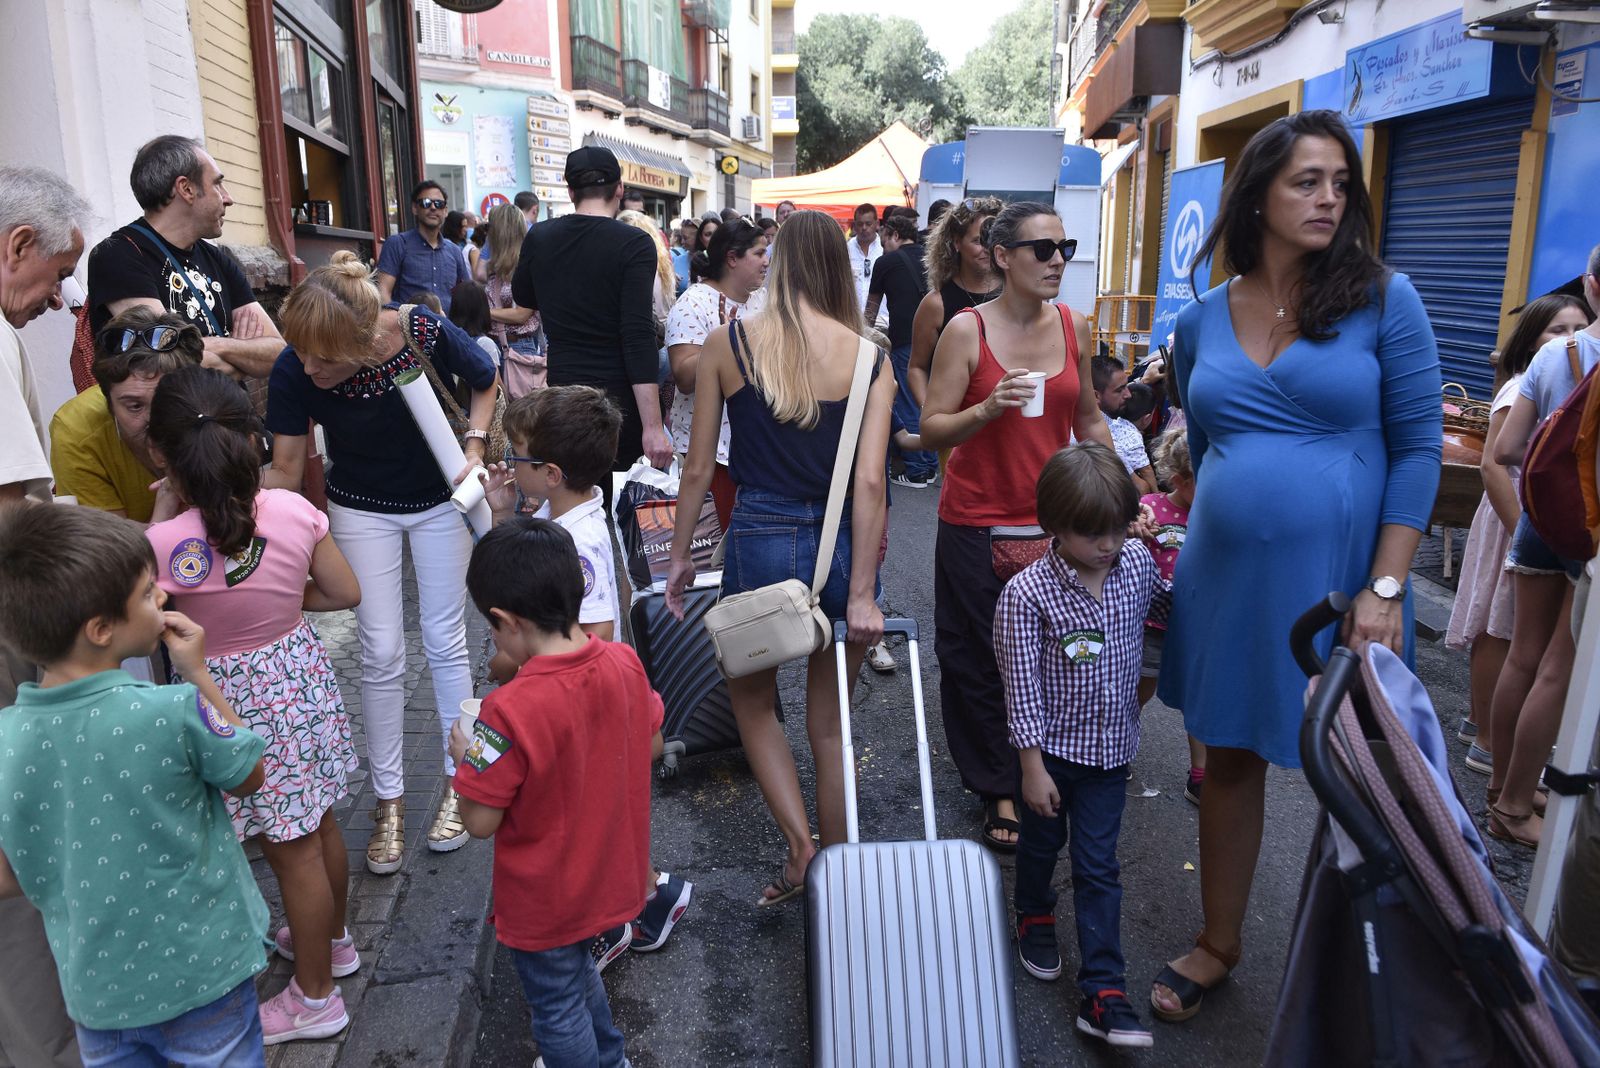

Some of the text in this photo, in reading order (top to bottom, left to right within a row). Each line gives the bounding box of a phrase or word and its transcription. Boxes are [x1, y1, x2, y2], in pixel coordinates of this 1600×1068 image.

[488, 51, 550, 66] CANDILEJO
[1366, 44, 1408, 72] Pescados
[1413, 48, 1420, 66] y
[628, 164, 665, 188] LA BODEGA
[636, 538, 713, 559] HEINENN
[233, 566, 252, 581] LOCAL
[484, 728, 503, 745] LOCAL
